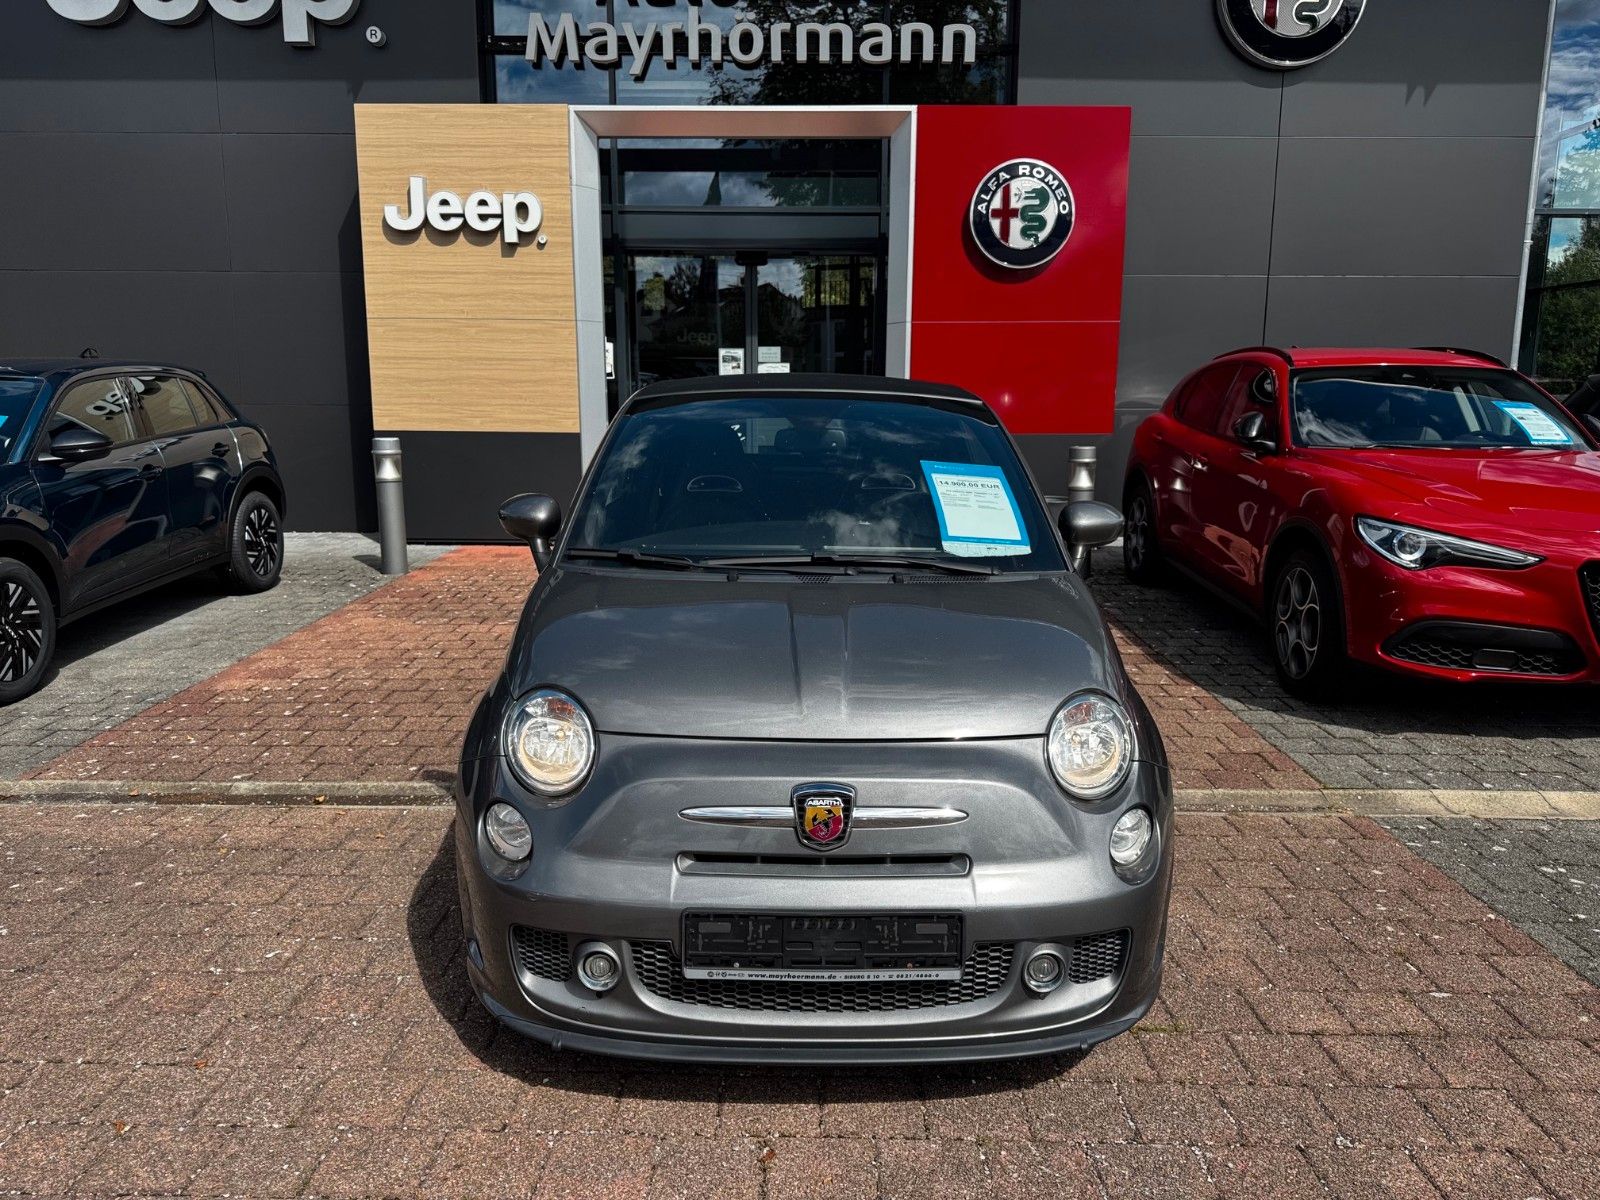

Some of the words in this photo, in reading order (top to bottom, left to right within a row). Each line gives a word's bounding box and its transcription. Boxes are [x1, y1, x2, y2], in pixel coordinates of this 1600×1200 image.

[523, 6, 977, 76] Mayrhörmann
[383, 175, 543, 245] Jeep
[977, 171, 1011, 214] ALFA
[1018, 164, 1070, 215] ROMEO
[980, 482, 1001, 490] EUR
[747, 972, 837, 980] www.mayrhoermann.de
